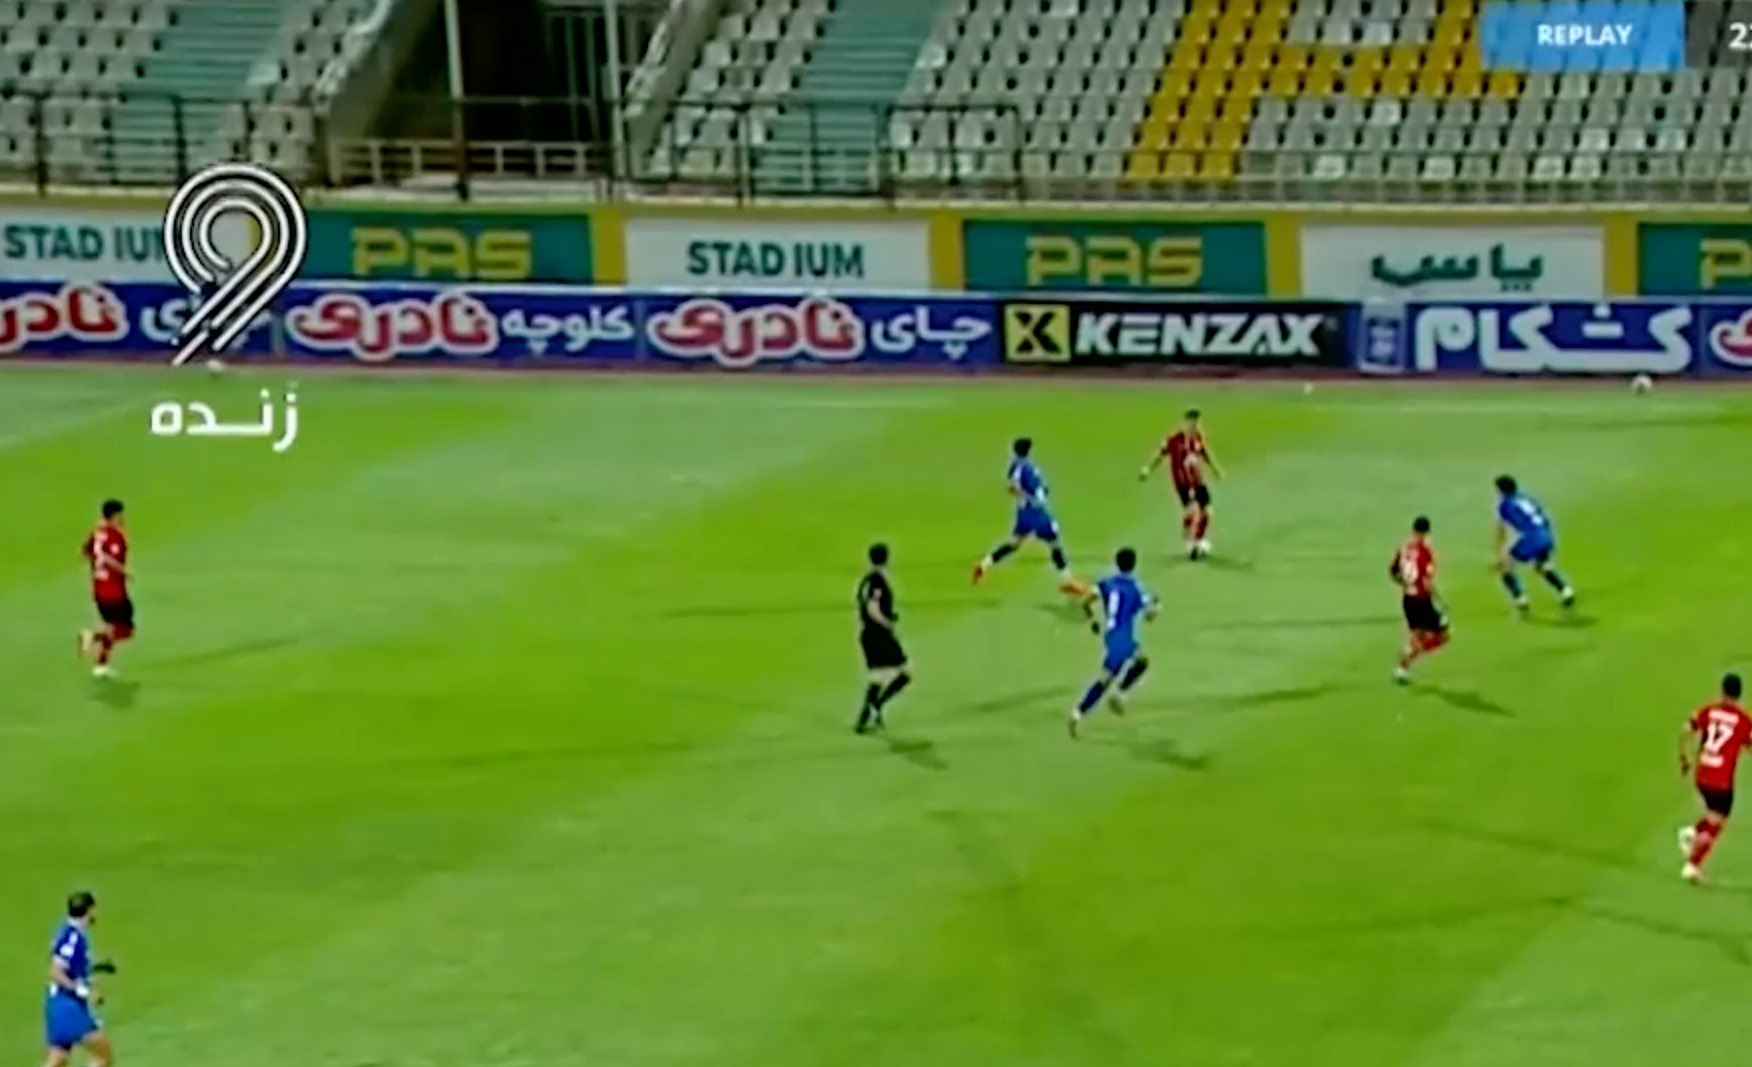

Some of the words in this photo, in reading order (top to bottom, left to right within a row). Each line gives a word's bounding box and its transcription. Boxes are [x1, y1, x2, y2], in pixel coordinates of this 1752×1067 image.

[4, 224, 175, 262] STADIU
[350, 226, 532, 279] PAS
[1025, 235, 1202, 287] PAS
[287, 290, 498, 361] نادری
[502, 307, 636, 352] کلوچه
[646, 299, 865, 366] نادری
[871, 310, 992, 359] چای
[1078, 311, 1323, 356] KENZAX
[1414, 304, 1695, 373] کشکام
